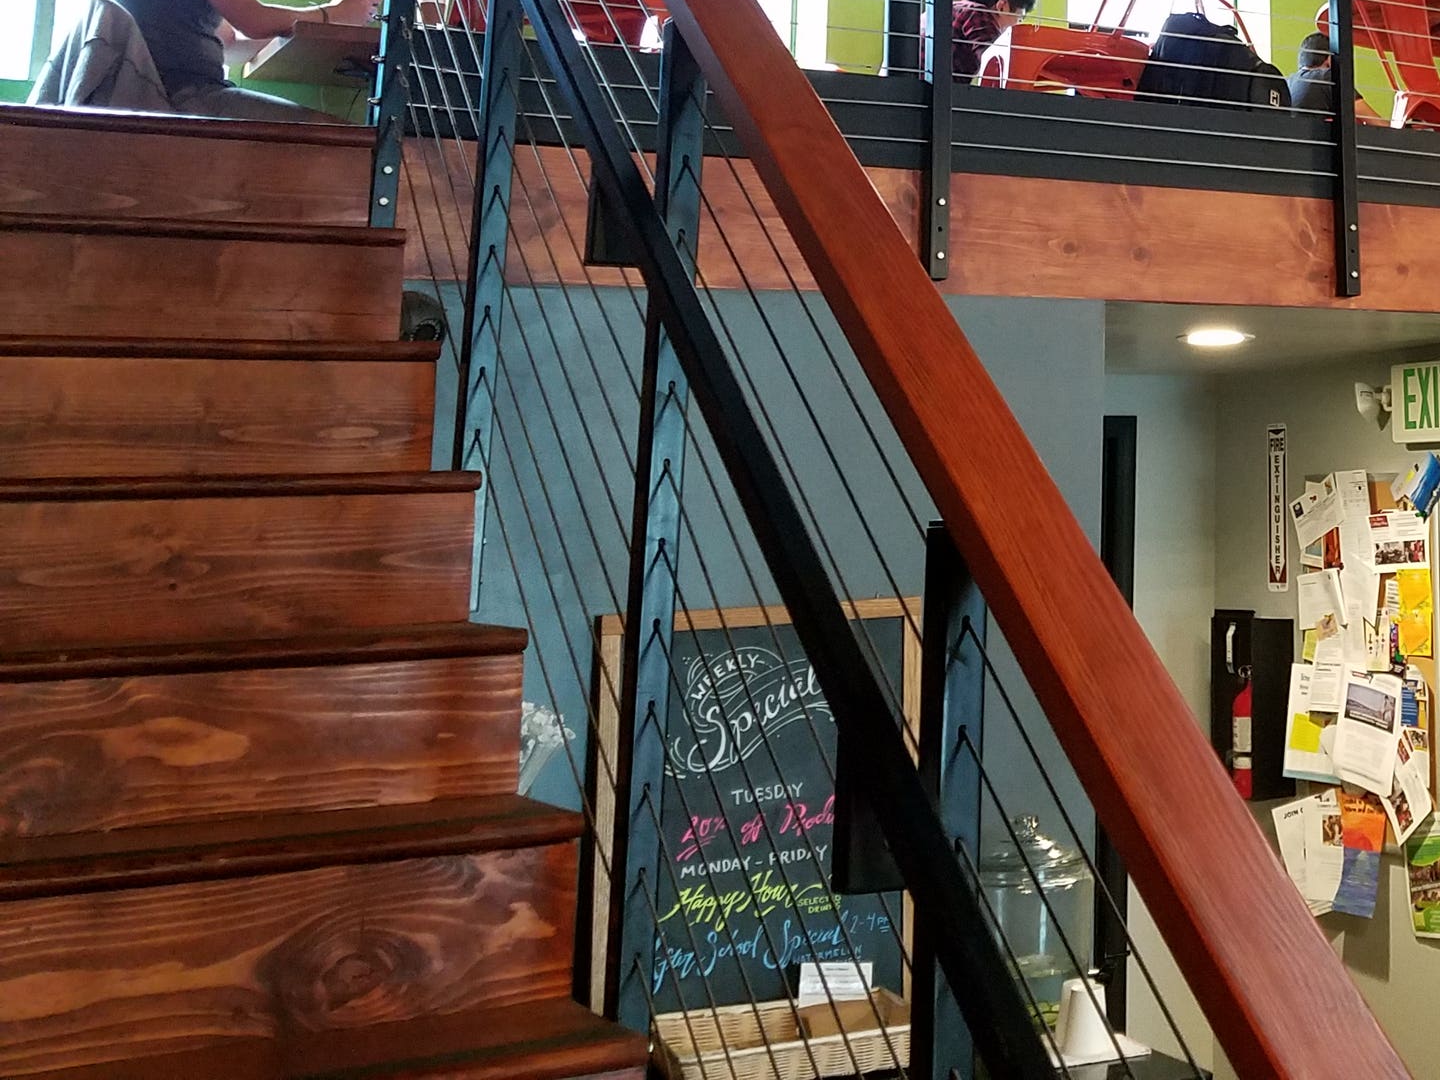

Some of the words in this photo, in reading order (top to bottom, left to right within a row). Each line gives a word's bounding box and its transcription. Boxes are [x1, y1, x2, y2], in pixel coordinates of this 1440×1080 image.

[1270, 437, 1284, 452] FIRE
[1273, 454, 1282, 574] EXTINGUISHER
[740, 813, 767, 846] off
[798, 894, 842, 908] SELECTD
